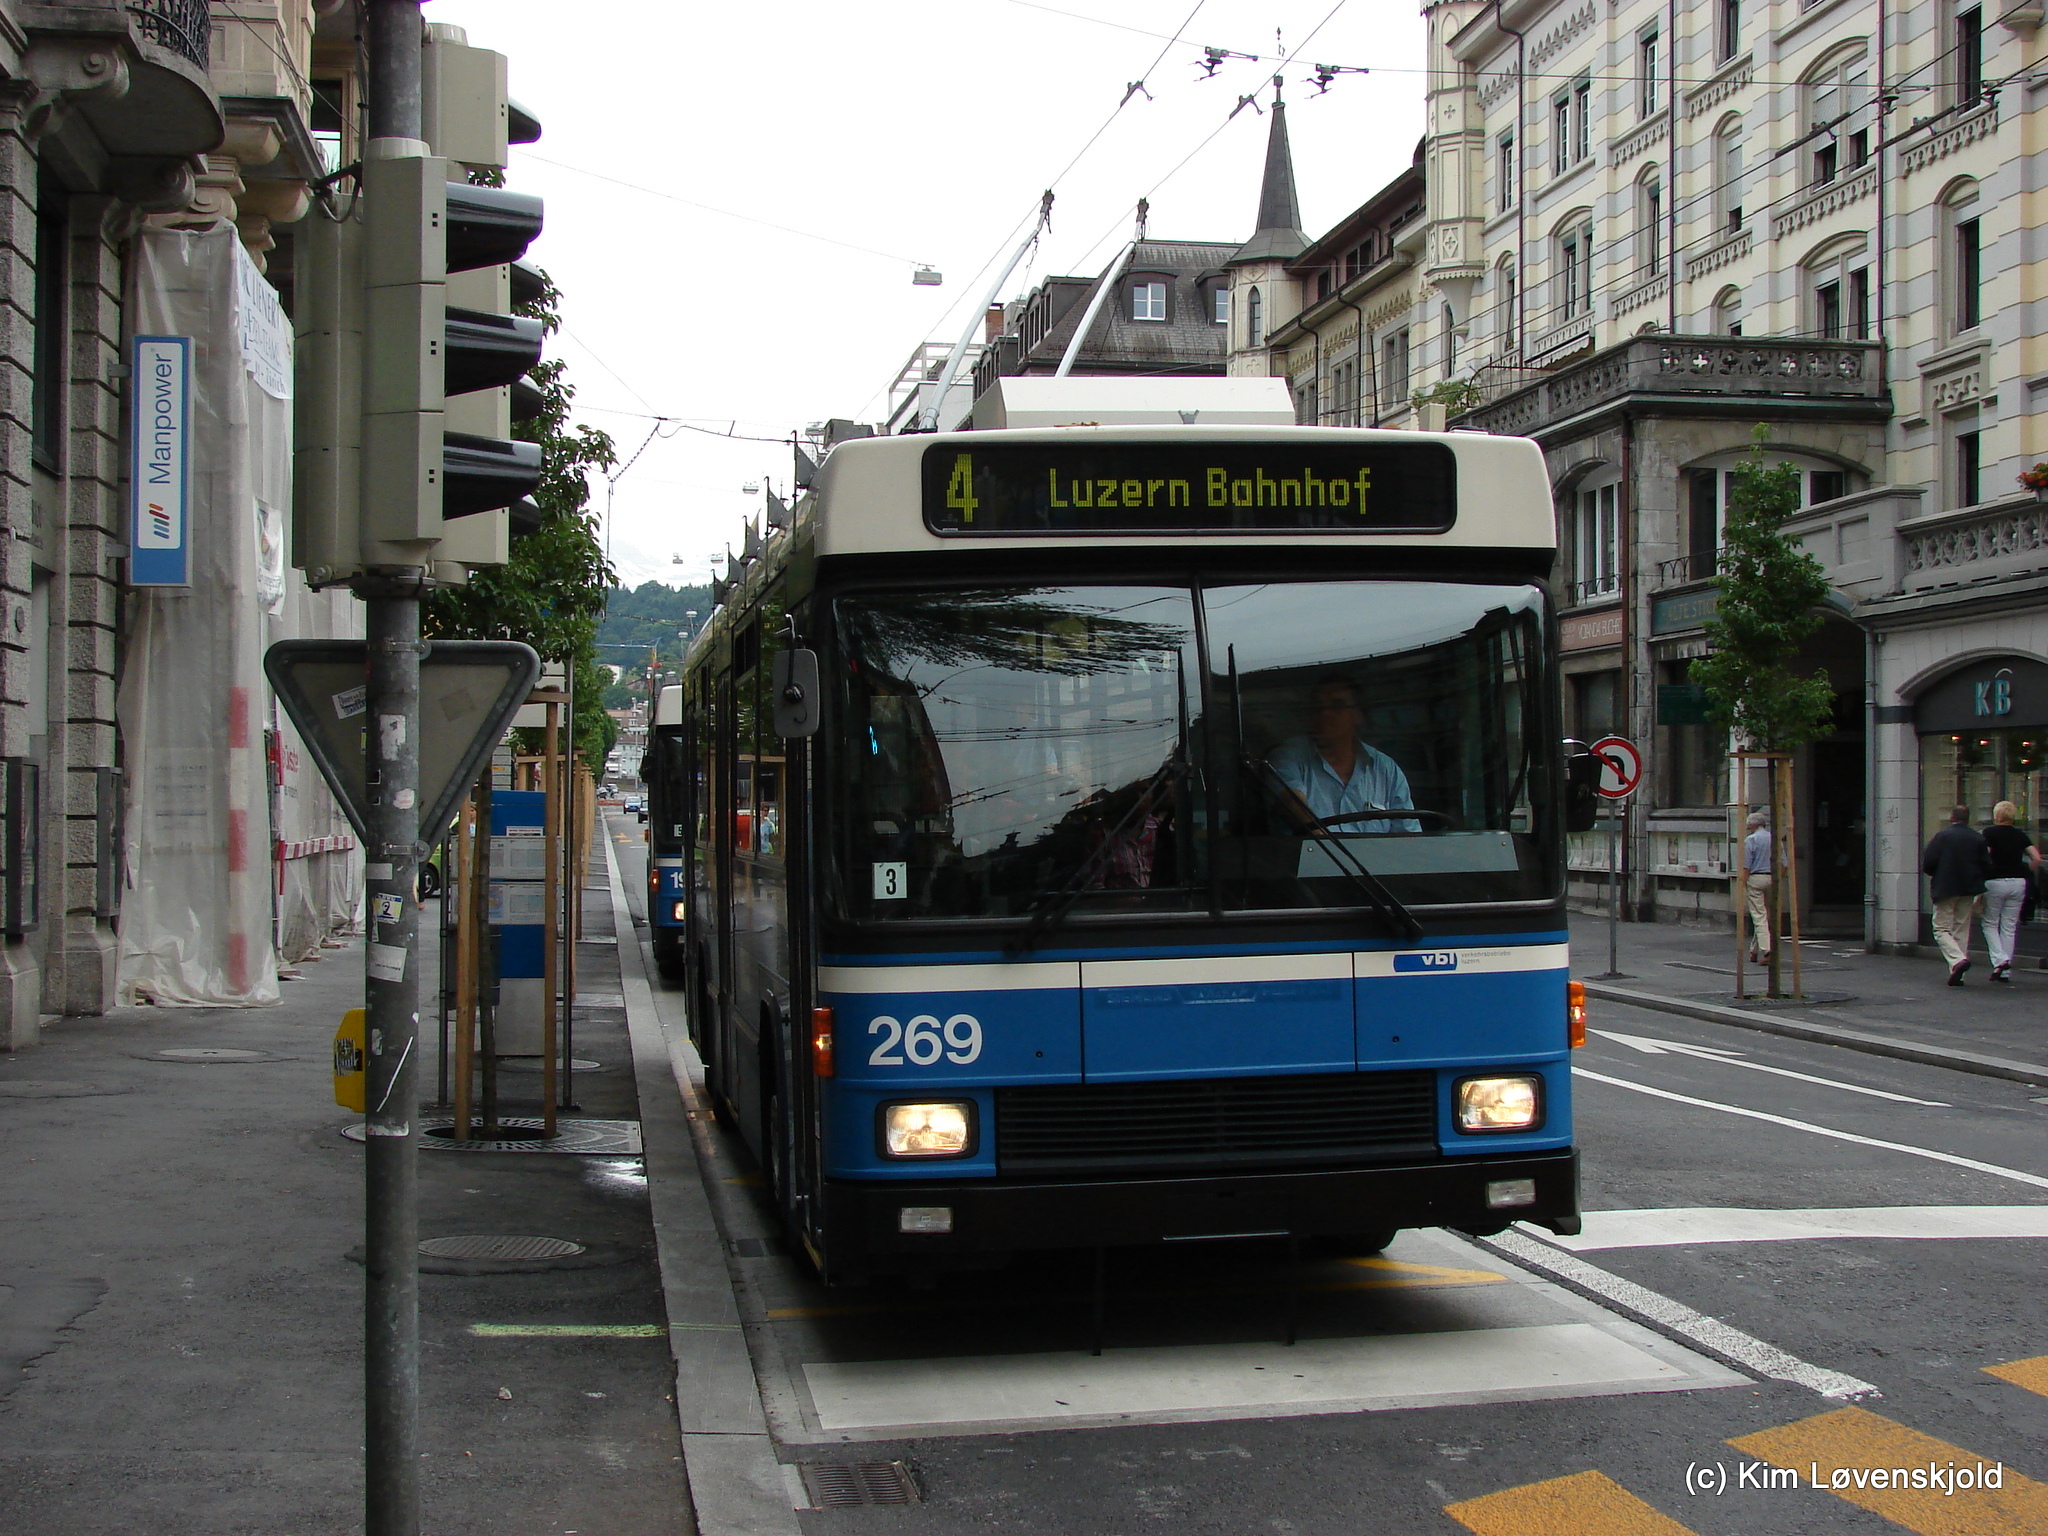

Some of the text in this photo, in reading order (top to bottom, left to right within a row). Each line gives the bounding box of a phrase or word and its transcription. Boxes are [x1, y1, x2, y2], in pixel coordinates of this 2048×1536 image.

[149, 353, 177, 484] Manpower
[947, 454, 1371, 522] 4 Luzern Bahnhof
[1975, 680, 2011, 716] KB
[886, 868, 897, 895] 3
[1421, 952, 1455, 966] vbl
[868, 1014, 983, 1065] 269
